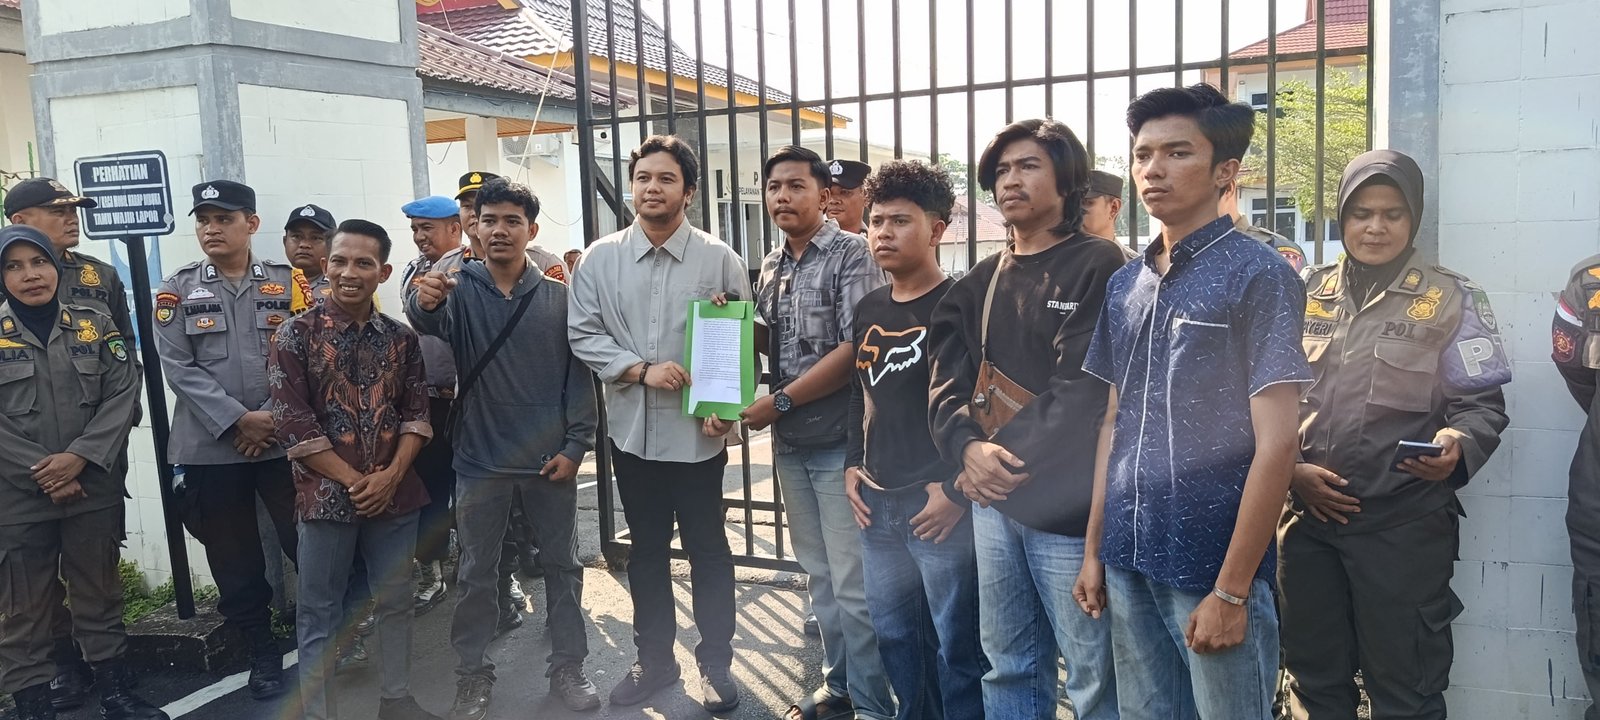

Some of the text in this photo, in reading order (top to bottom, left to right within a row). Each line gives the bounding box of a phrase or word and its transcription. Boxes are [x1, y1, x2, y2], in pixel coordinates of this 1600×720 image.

[92, 163, 148, 183] PERHATIAN
[93, 210, 159, 226] TAMU WAJIB LAPOR
[1381, 321, 1416, 338] POL
[69, 344, 95, 356] POL
